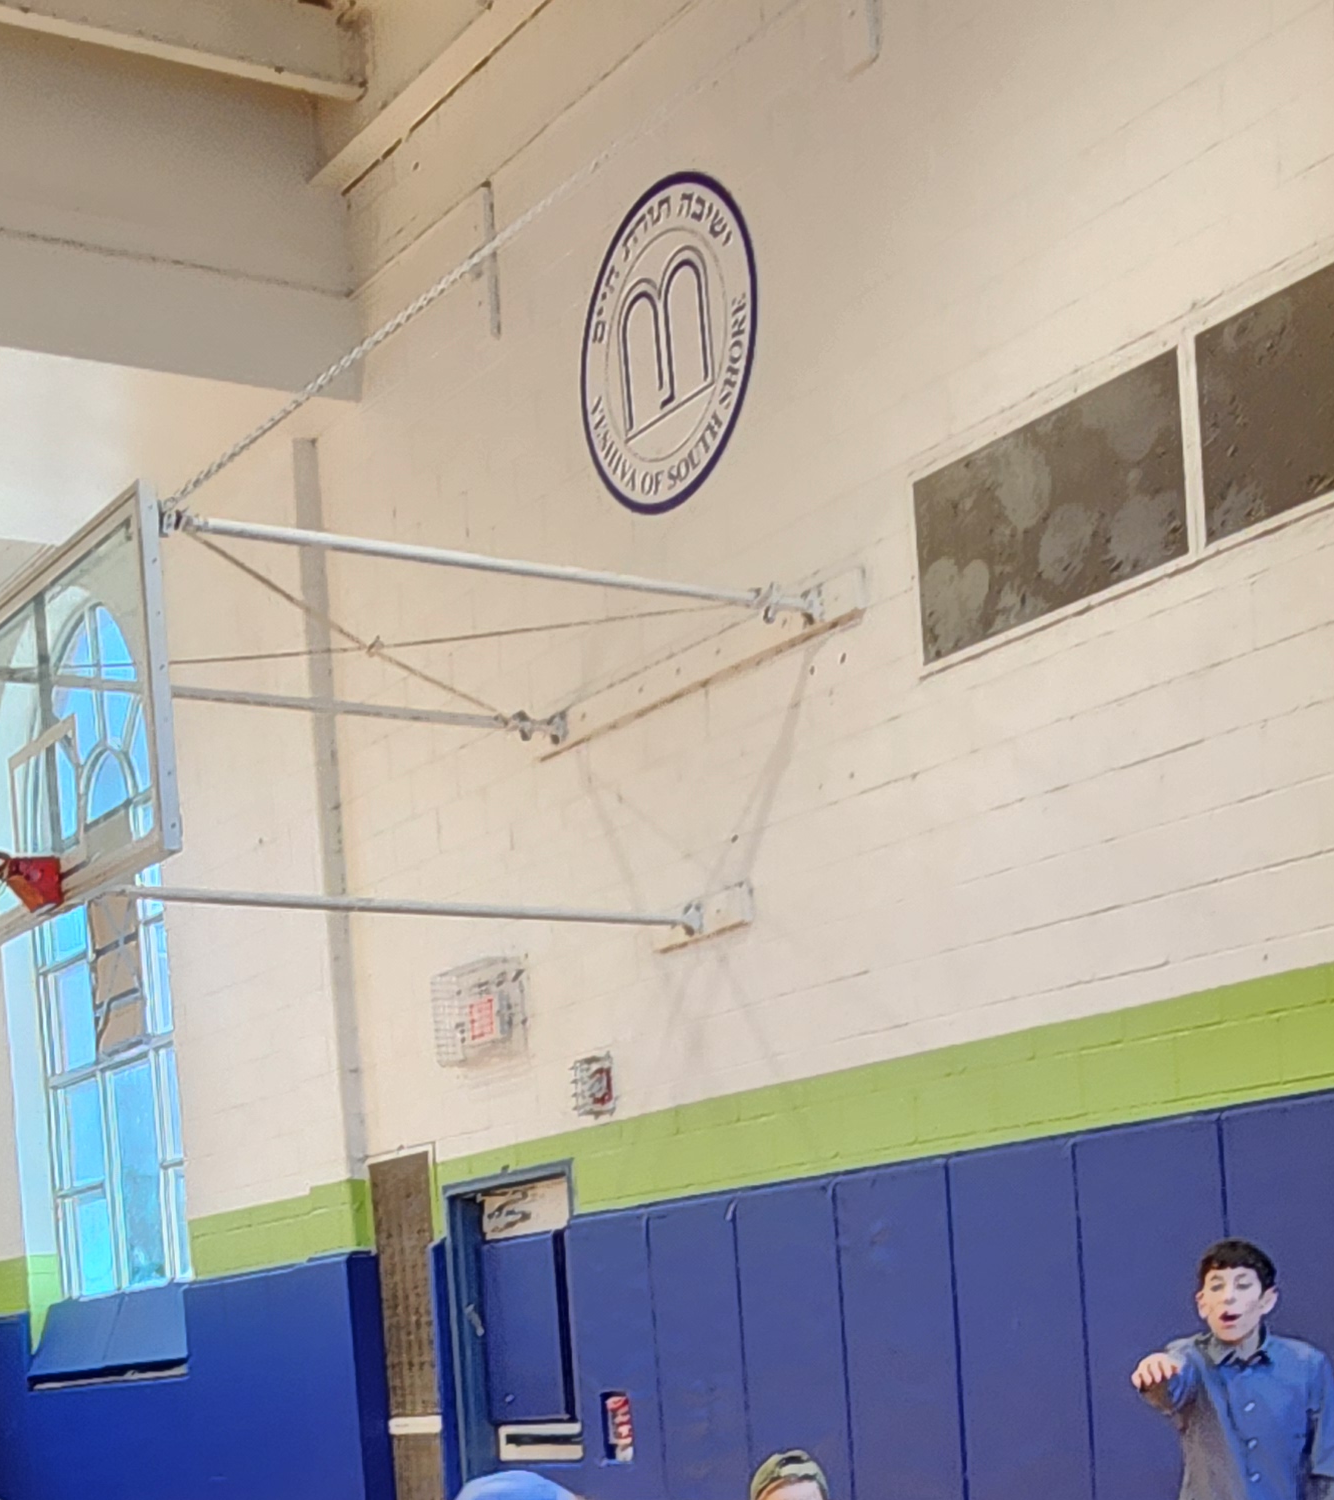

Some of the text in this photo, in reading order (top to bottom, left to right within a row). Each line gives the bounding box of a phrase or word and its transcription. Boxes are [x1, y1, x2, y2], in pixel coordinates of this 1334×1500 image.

[590, 292, 747, 496] YESHIVA OF SOUTH SHORE
